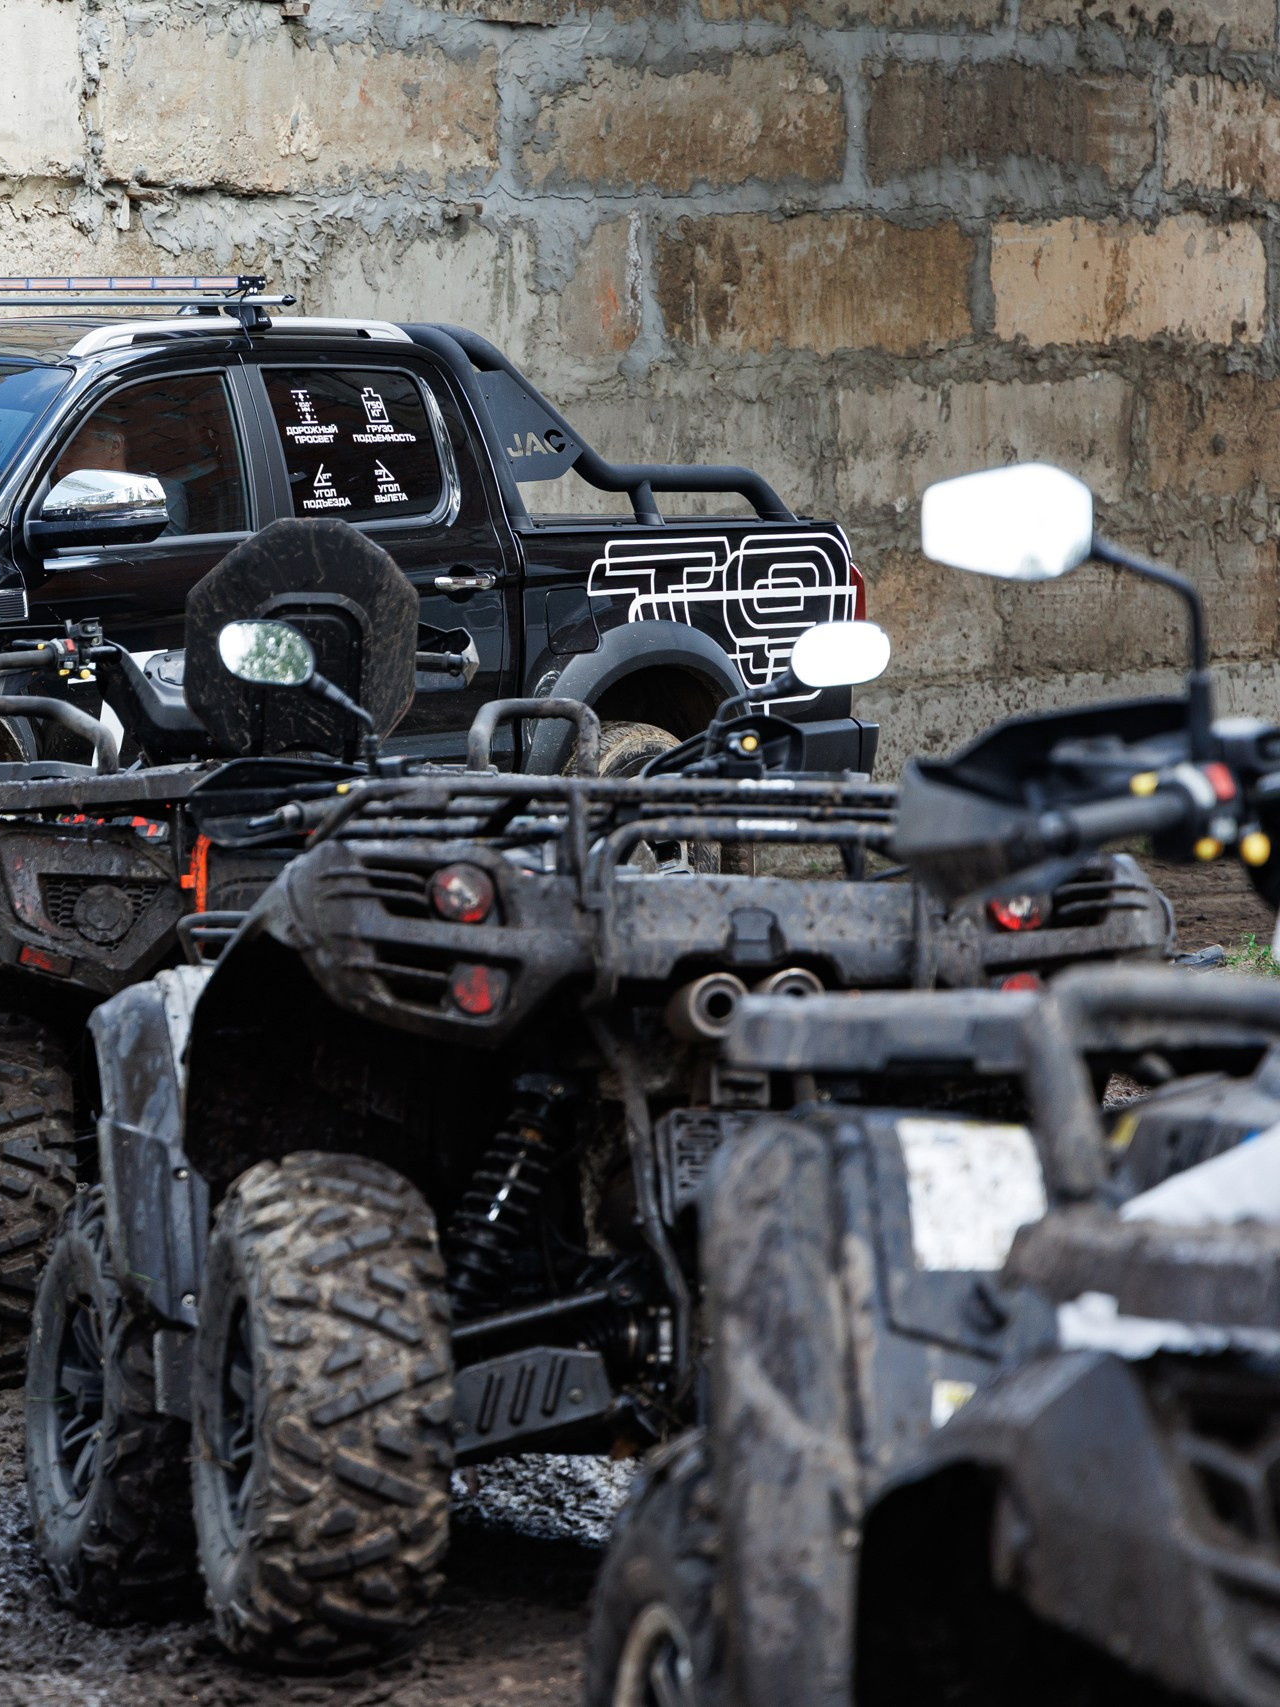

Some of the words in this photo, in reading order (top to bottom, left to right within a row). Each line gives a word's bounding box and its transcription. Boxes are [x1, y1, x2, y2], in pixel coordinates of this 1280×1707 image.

[285, 423, 339, 436] ДОРОЖНЫЙ
[365, 424, 395, 433] ГРУЗО
[294, 434, 335, 444] ПРОСВЕТ
[352, 433, 417, 443] ПОДЪЕМНОСТЬ
[506, 428, 566, 457] JAC
[313, 488, 337, 498] УГОЛ
[377, 483, 401, 493] УГОЛ
[373, 492, 409, 503] ВЫЛЕТА
[302, 497, 352, 509] ПОДЪЕЗДА
